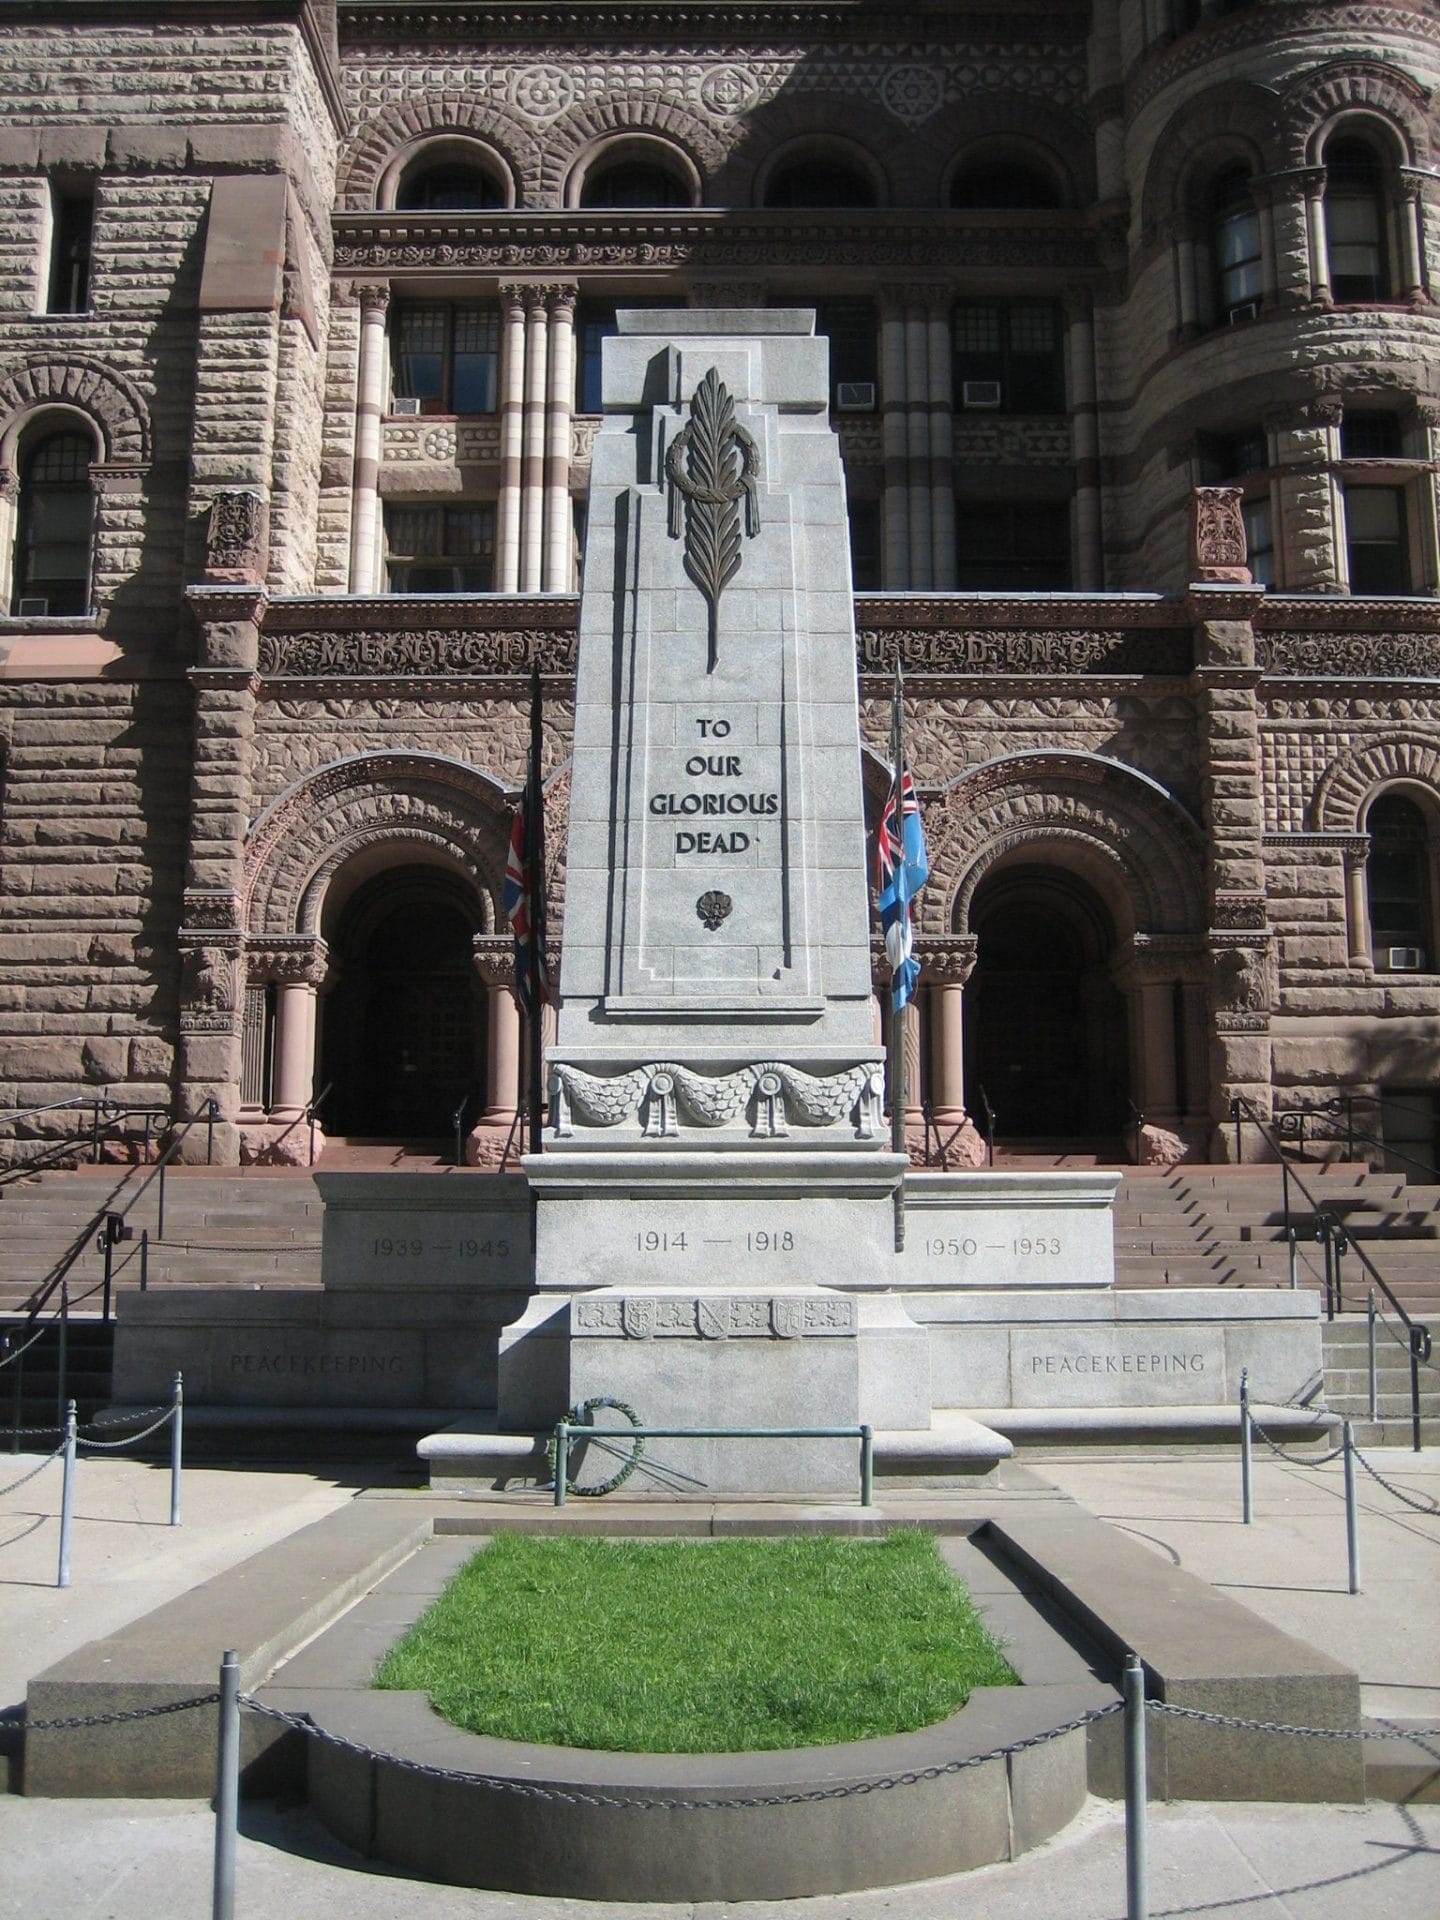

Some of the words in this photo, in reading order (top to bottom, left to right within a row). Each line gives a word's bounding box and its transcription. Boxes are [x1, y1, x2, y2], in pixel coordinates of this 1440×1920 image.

[696, 719, 731, 737] TO
[685, 755, 743, 776] OUR
[649, 793, 779, 815] GLORIOUS
[675, 832, 750, 854] DEAD
[374, 1238, 423, 1257] 1939
[459, 1239, 509, 1257] 1945
[636, 1231, 688, 1251] 1914
[747, 1231, 794, 1251] 1918
[926, 1238, 977, 1256] 1950
[1013, 1238, 1061, 1256] 1953
[230, 1354, 402, 1374] PEACEKEEPING
[1032, 1354, 1205, 1374] PEACEKEEPING
